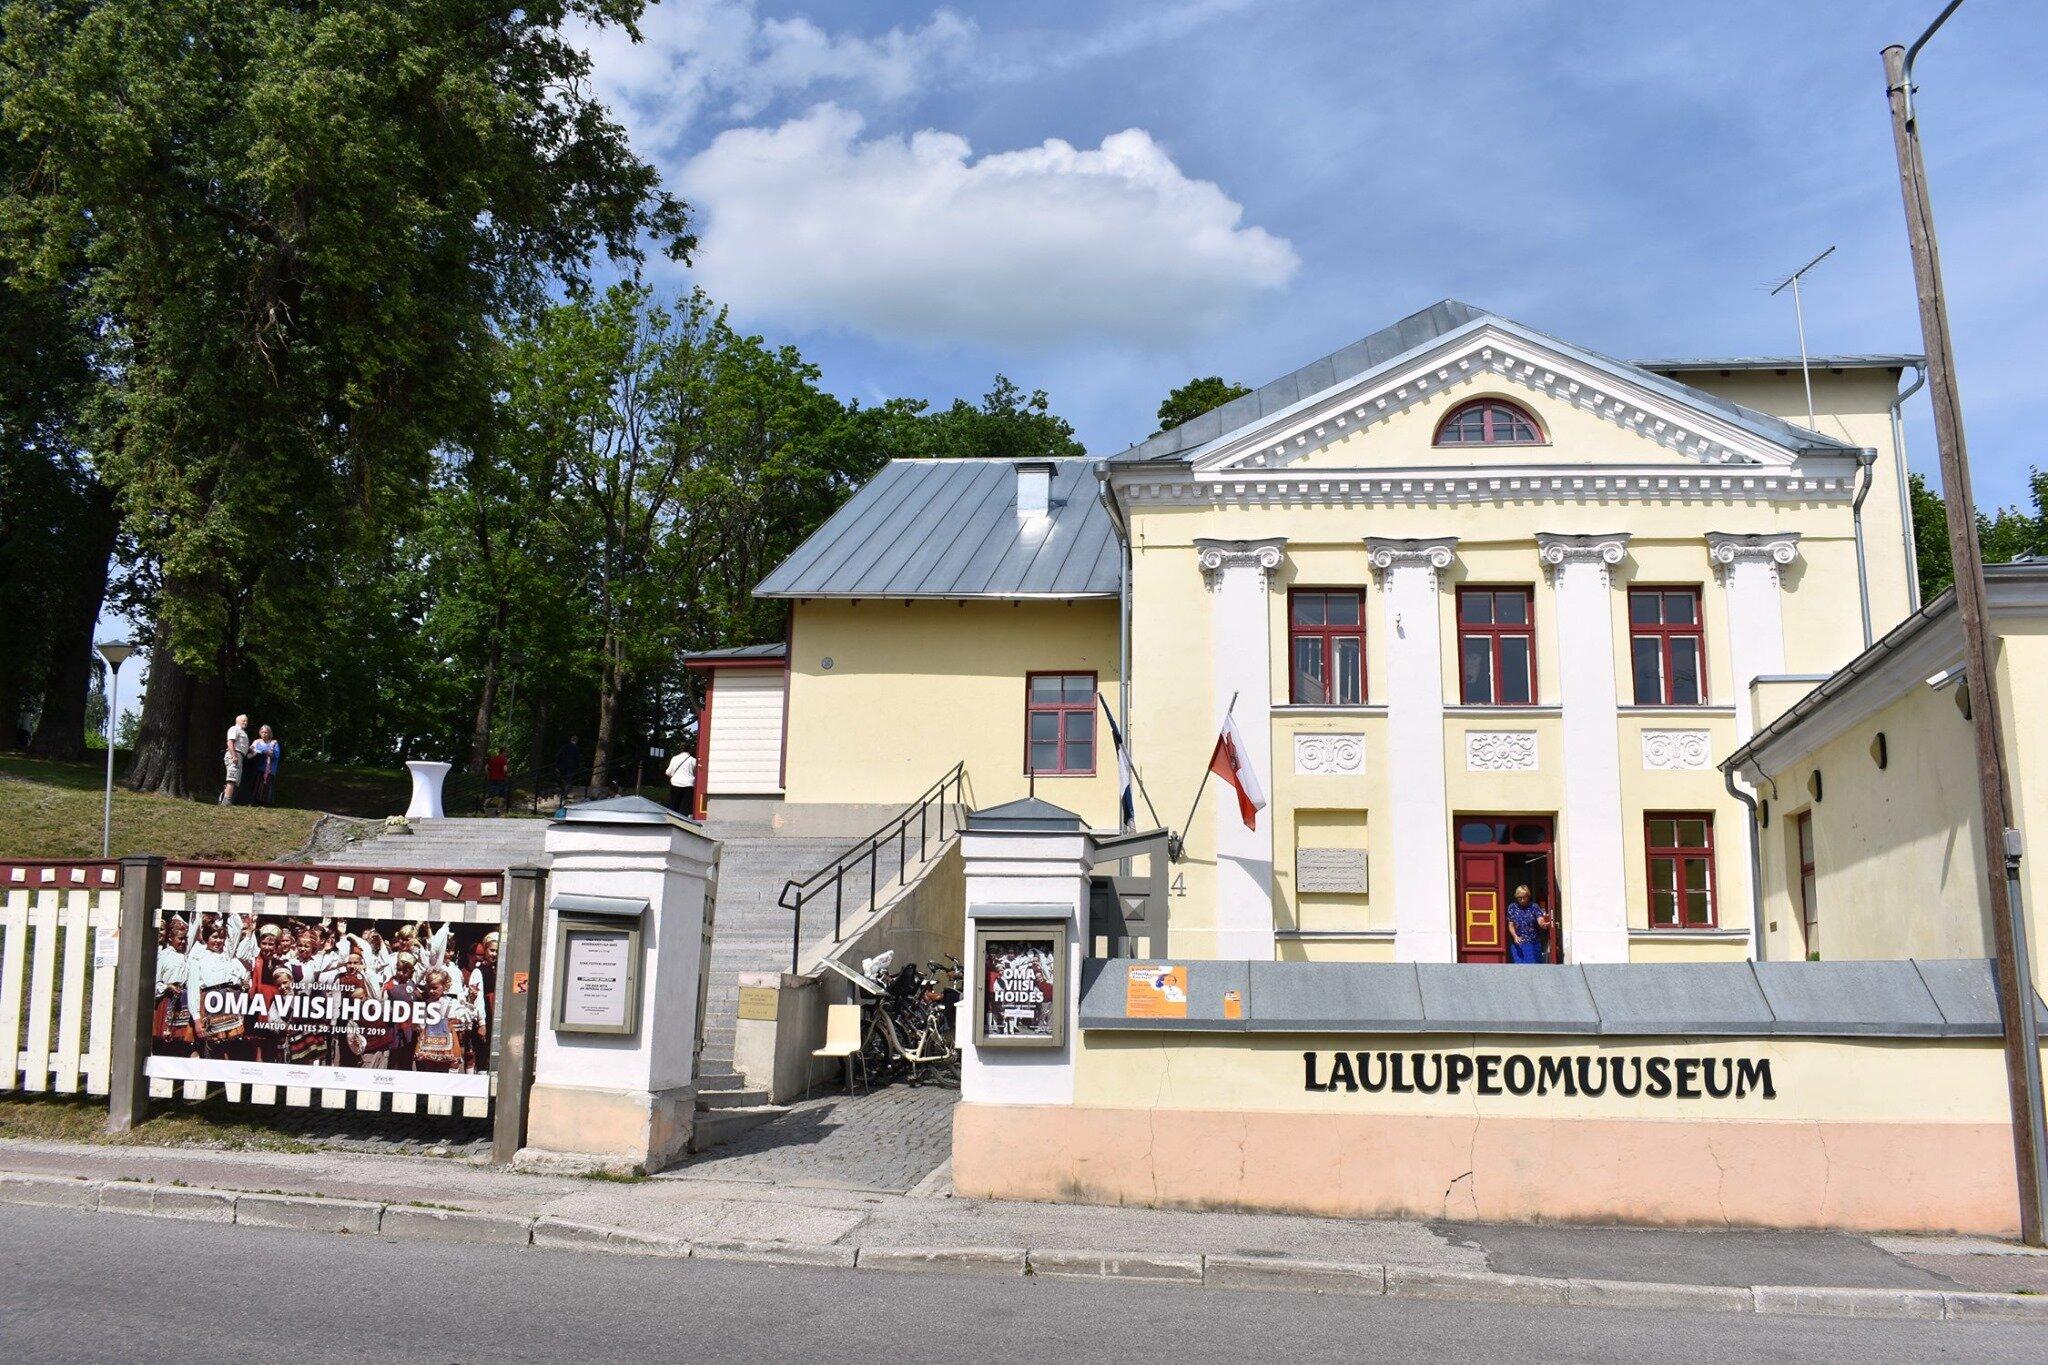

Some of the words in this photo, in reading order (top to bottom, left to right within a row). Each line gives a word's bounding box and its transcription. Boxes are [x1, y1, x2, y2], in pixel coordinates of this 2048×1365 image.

[1168, 872, 1187, 897] 4
[1003, 968, 1036, 980] OMA
[290, 982, 306, 990] UUS
[1004, 979, 1034, 991] VIISI
[994, 991, 1044, 1003] HOIDES
[204, 990, 268, 1016] OMA
[275, 994, 334, 1020] VIISI
[341, 997, 442, 1025] HOIDES
[253, 1021, 286, 1031] AVATUD
[287, 1023, 317, 1033] ALATES
[319, 1025, 331, 1034] 20.
[331, 1026, 365, 1035] JUUNIST
[367, 1027, 386, 1036] 2019
[1303, 1051, 1777, 1100] LAULUPEOMUUSEUM
